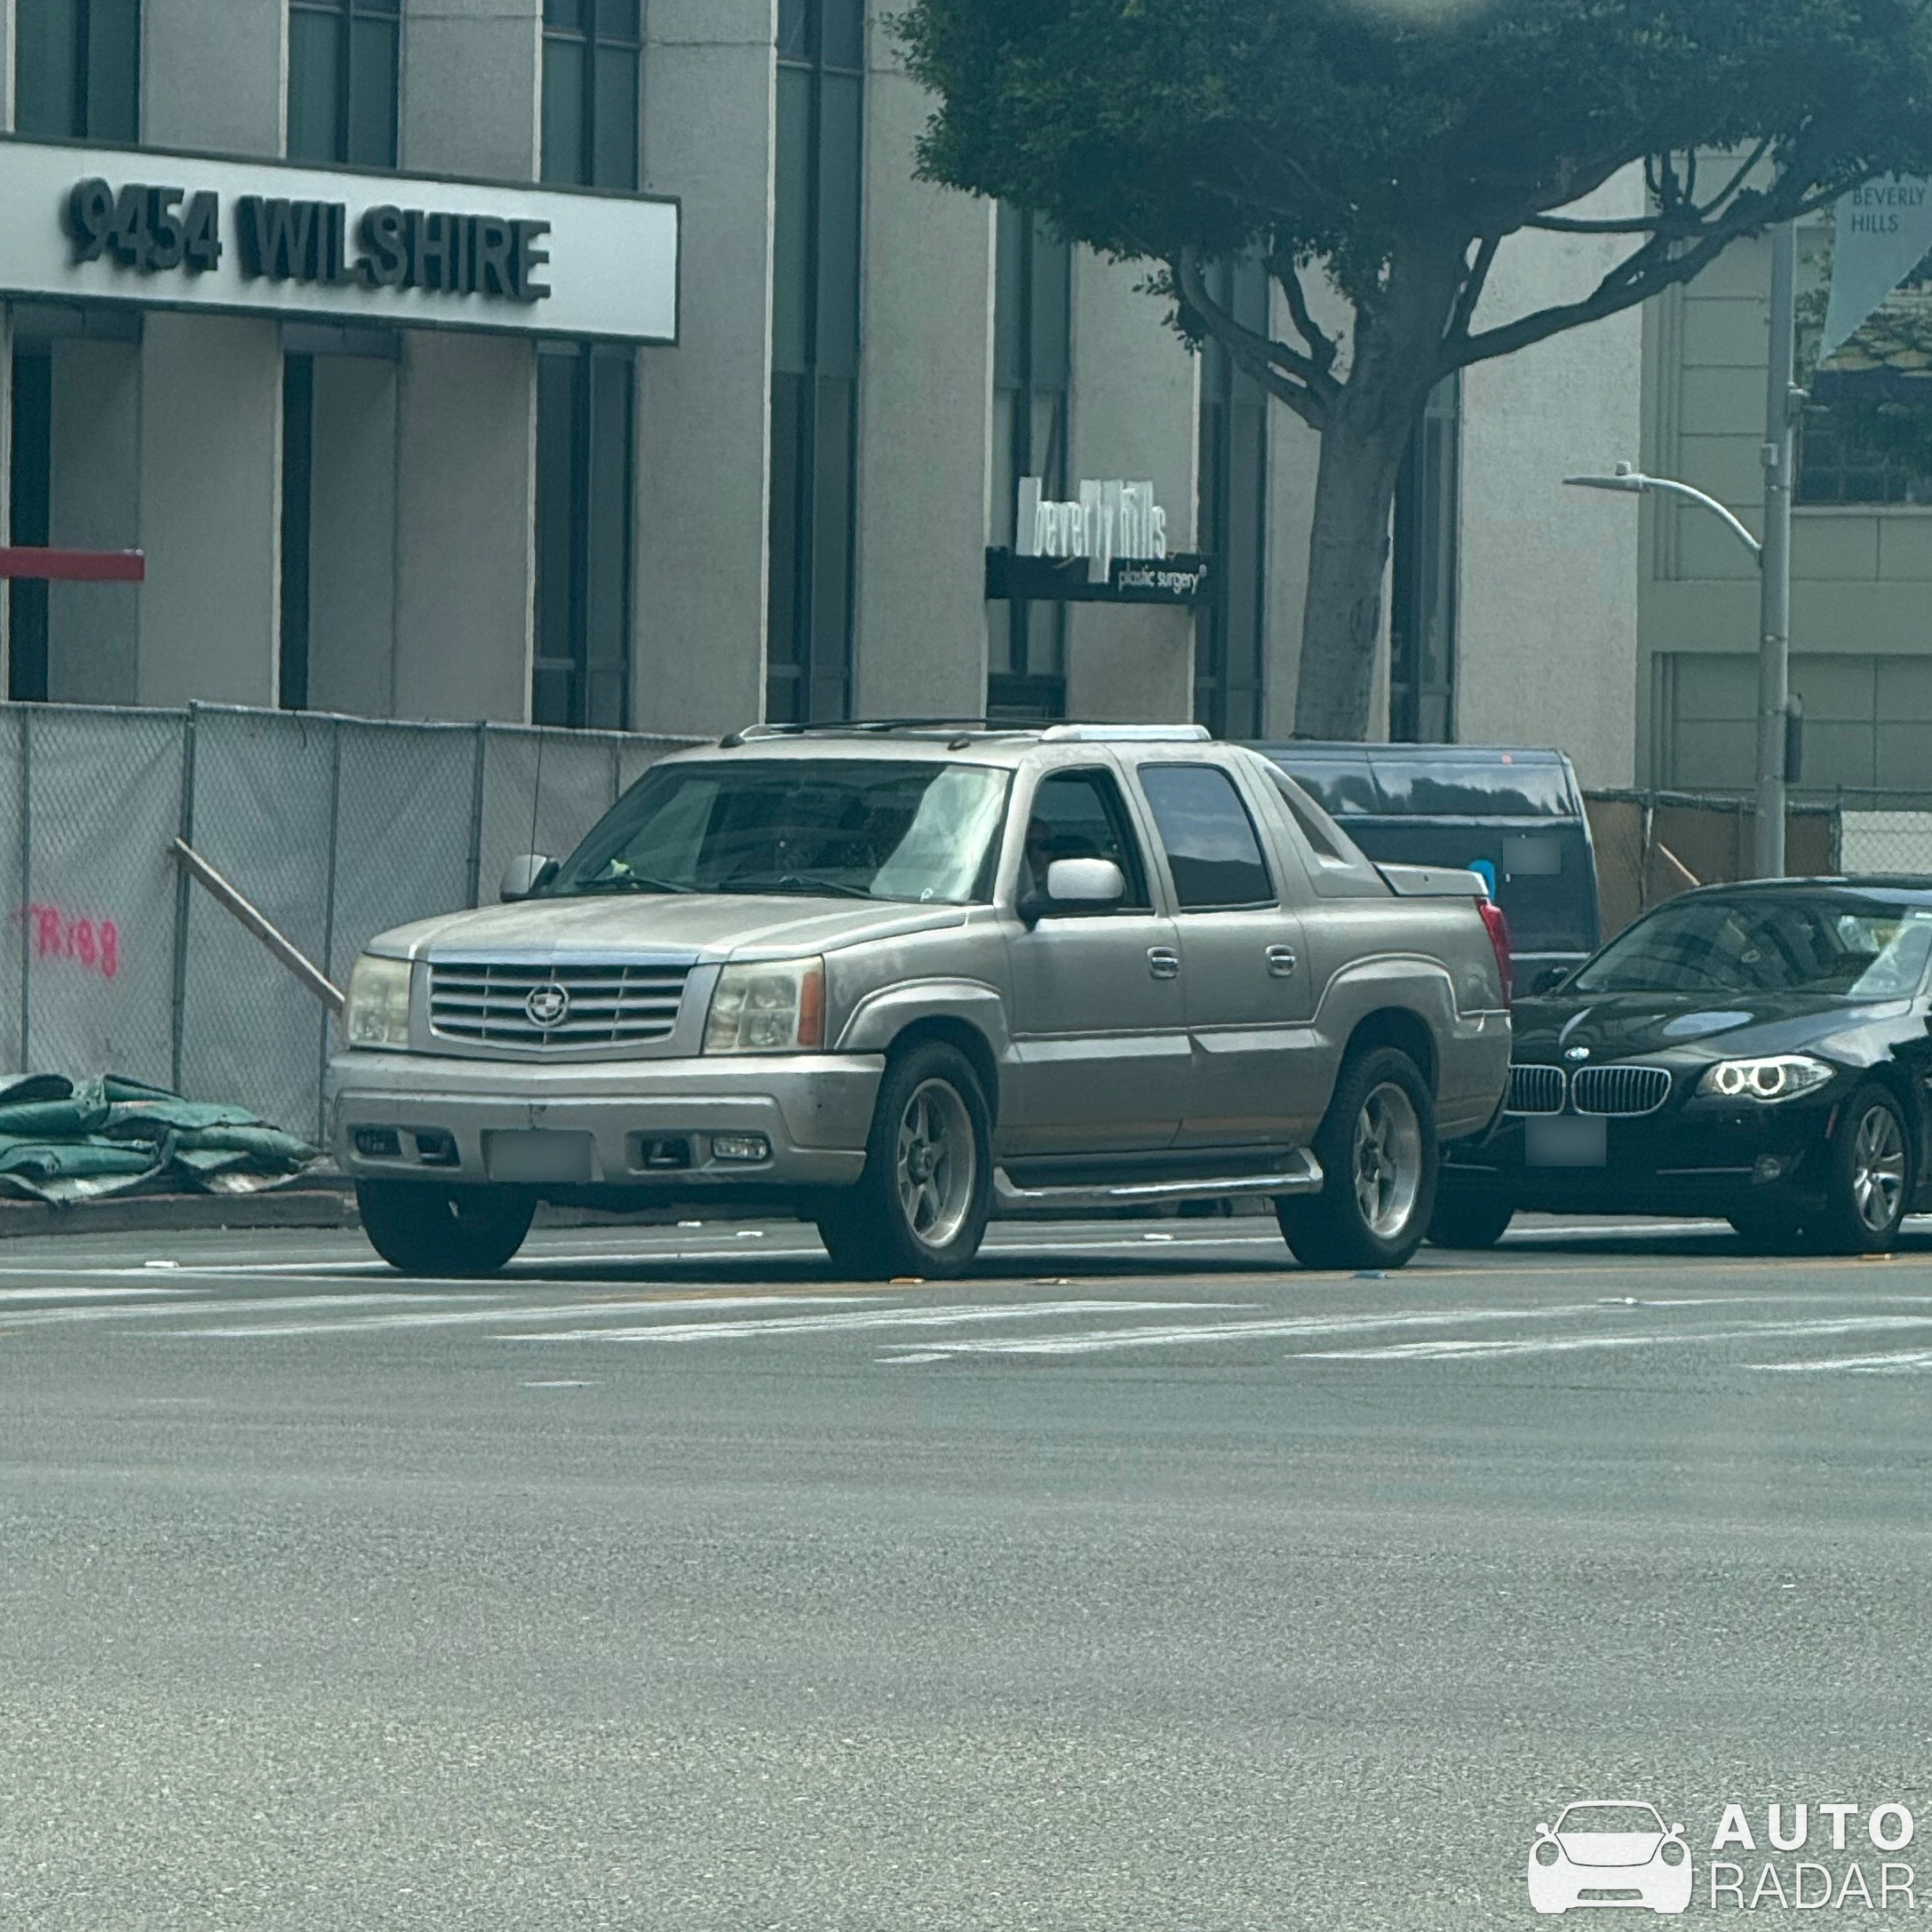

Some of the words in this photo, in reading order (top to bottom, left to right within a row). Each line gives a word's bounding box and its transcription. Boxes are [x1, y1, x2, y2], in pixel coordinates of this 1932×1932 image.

[1853, 186, 1927, 206] BEVERLY
[1851, 213, 1899, 234] HILLS
[69, 177, 222, 270] 9454
[234, 195, 551, 300] WILSHIRE
[1118, 561, 1155, 592] plastic
